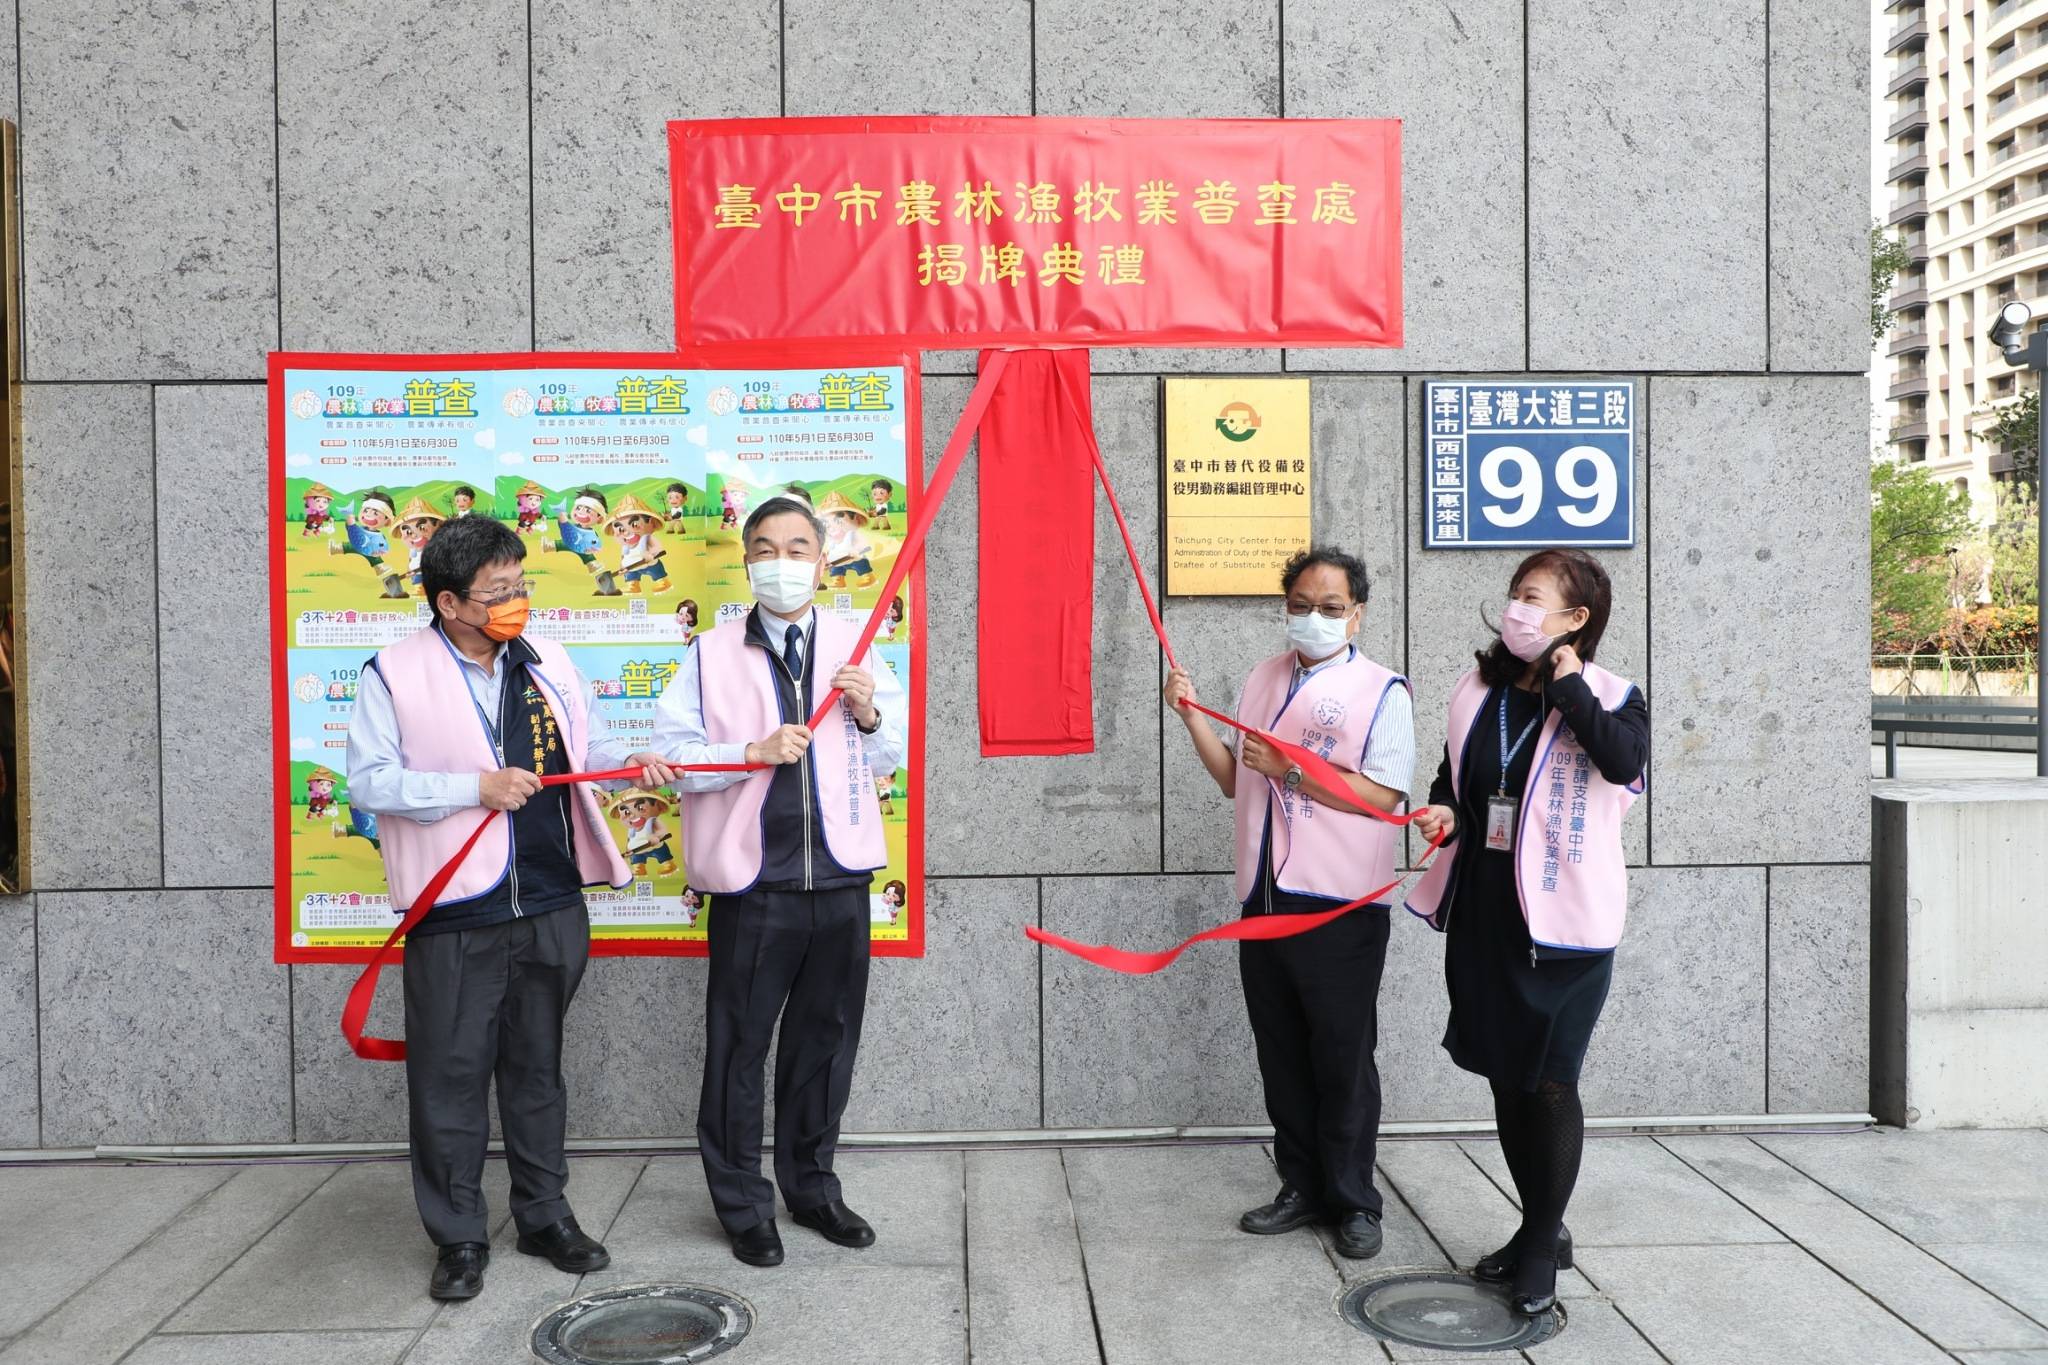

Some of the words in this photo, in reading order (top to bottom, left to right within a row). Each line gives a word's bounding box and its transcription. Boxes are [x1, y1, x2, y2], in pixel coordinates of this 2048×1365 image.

[713, 181, 1359, 229] 臺中市農林漁牧業普查處
[918, 242, 1148, 289] 揭牌典禮
[1434, 388, 1460, 433] 臺中市
[1469, 389, 1626, 426] 臺灣大道三段
[352, 438, 458, 448] 110年5月1日至6月30日
[564, 435, 670, 446] 110年5月1日至6月30日
[769, 432, 874, 444] 110年5月1日至6月30日
[1173, 459, 1305, 473] 臺中市替代役備役
[1435, 440, 1461, 486] 西屯區
[1173, 481, 1305, 496] 役男勤務編組管理中心
[1479, 445, 1618, 528] 99
[1435, 494, 1461, 539] 惠來里
[1174, 536, 1212, 546] Taichung
[1217, 536, 1234, 546] City
[1240, 536, 1269, 545] Center
[1274, 536, 1287, 545] for
[1291, 536, 1306, 545] the
[1174, 549, 1222, 557] Administration
[1224, 549, 1231, 557] of
[1234, 549, 1249, 558] Duty
[1252, 549, 1259, 557] of
[1262, 549, 1272, 557] the
[1174, 561, 1205, 569] Draftee
[1210, 561, 1217, 569] of
[1223, 561, 1265, 569] Substitute
[1541, 752, 1571, 893] 109年農林漁牧業普查
